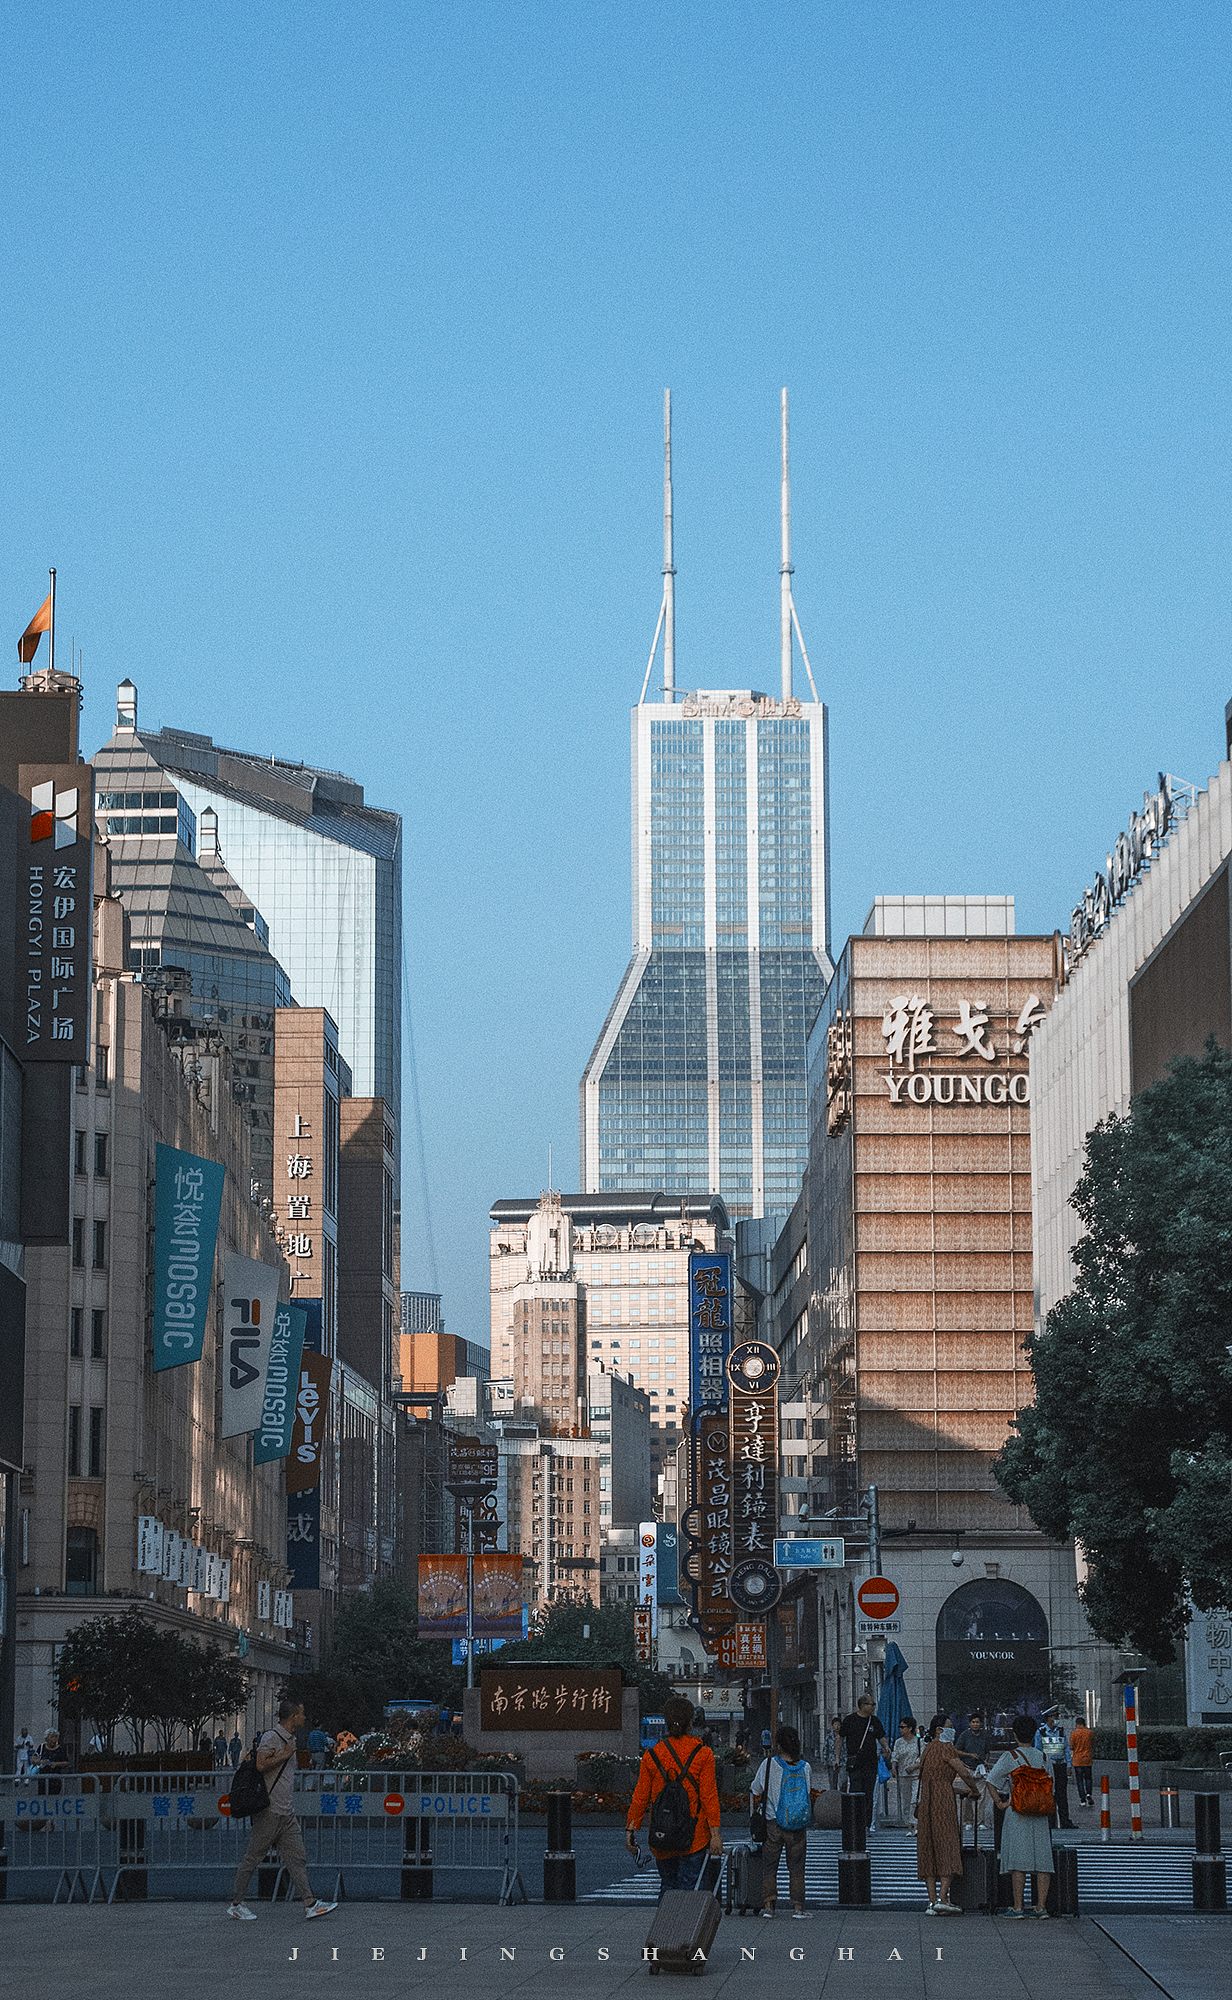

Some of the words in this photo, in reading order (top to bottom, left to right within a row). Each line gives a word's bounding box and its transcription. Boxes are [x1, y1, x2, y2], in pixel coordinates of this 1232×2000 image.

[27, 866, 43, 956] HONGYI
[50, 866, 77, 1041] 宏伊国际广场
[27, 969, 42, 1044] PLAZA
[229, 1298, 262, 1390] FILA
[483, 1464, 496, 1476] 9F
[490, 1684, 613, 1716] 南京路步行街
[16, 1799, 86, 1817] POLICE
[152, 1796, 195, 1817] 警察
[320, 1794, 363, 1814] 警察
[421, 1796, 491, 1813] POLICE
